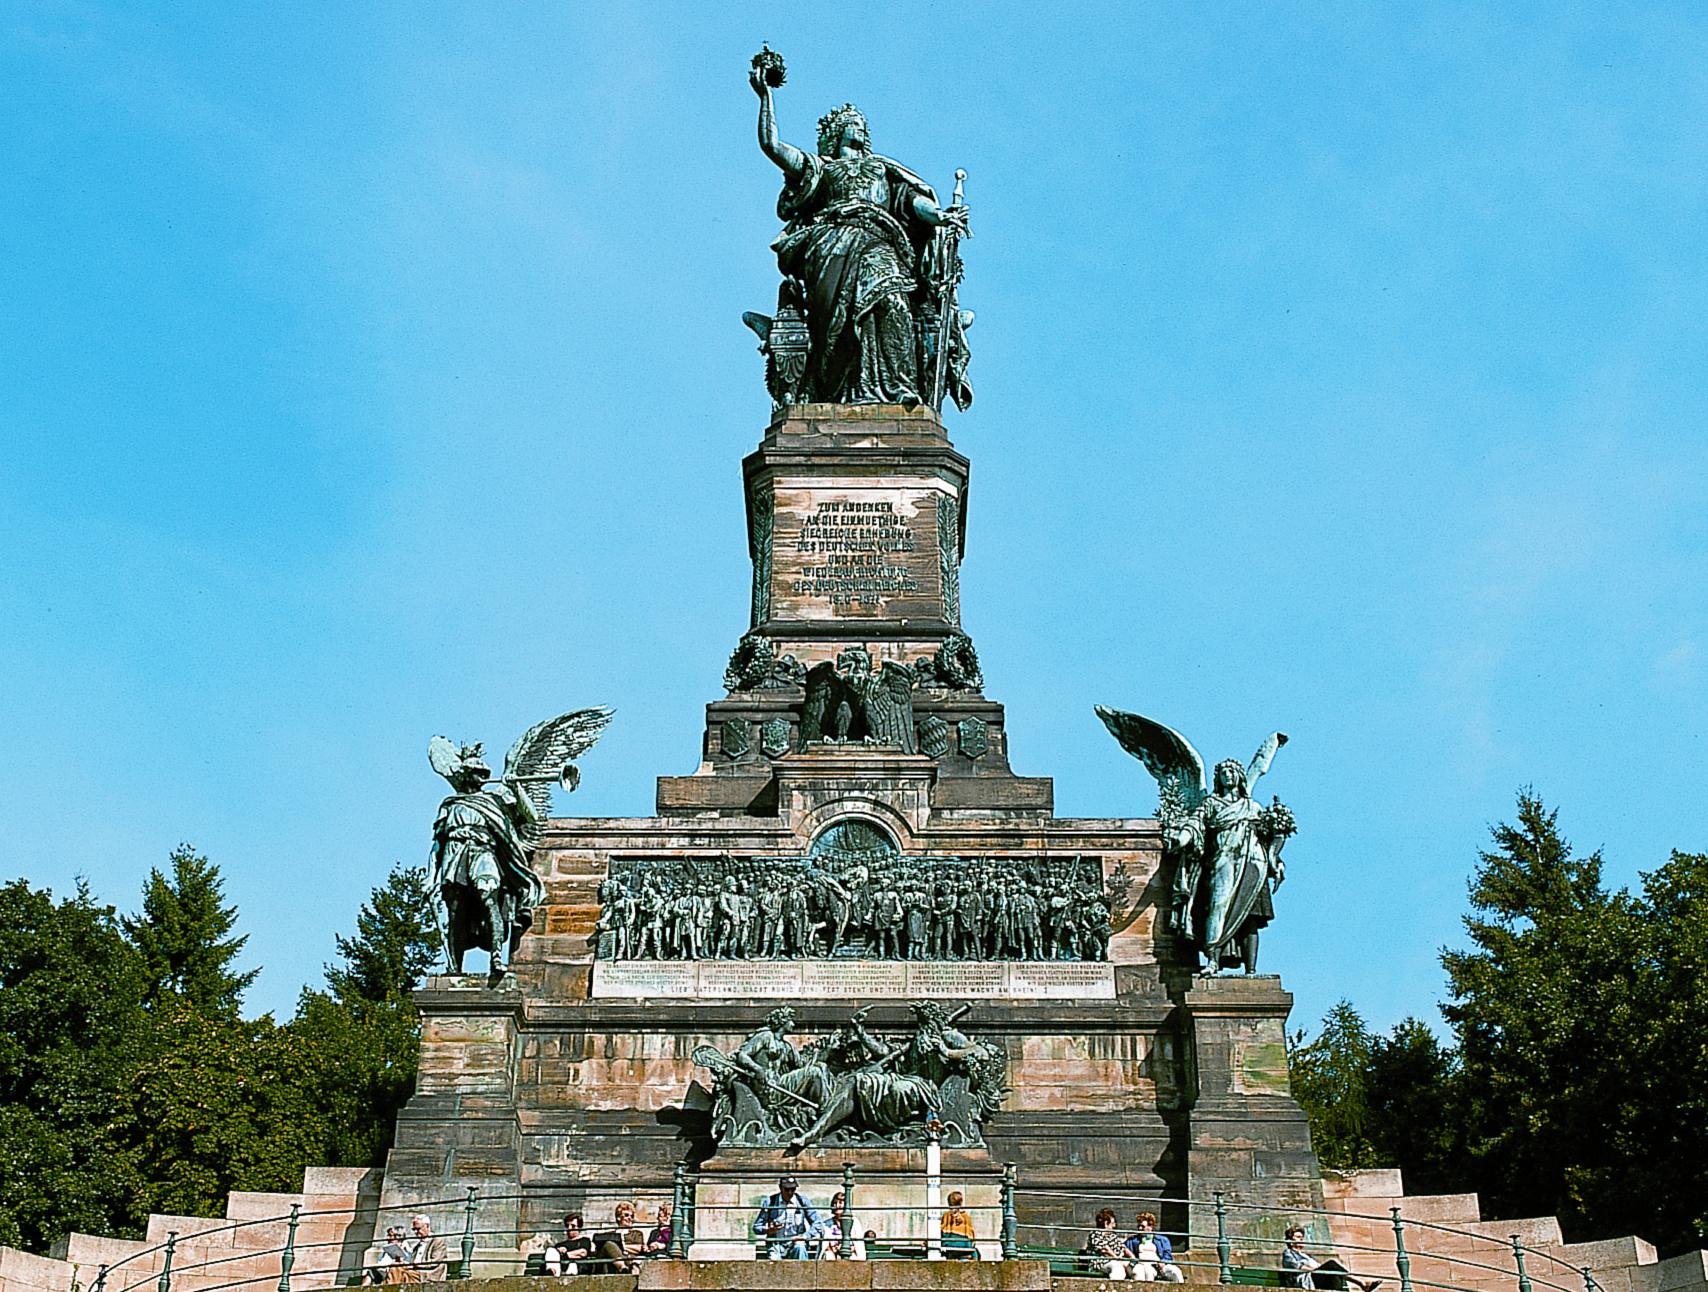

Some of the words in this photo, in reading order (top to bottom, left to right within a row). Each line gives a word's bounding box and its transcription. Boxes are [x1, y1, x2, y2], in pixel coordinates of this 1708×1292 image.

[818, 502, 840, 513] ZUM
[843, 501, 894, 513] ANDENKEN
[806, 515, 819, 526] AN
[822, 515, 839, 526] DIE
[840, 515, 905, 526] EINMUETHIGE
[799, 528, 858, 539] SIEGREICHE
[859, 528, 912, 539] ERHEBUNG
[797, 541, 816, 552] DES
[819, 541, 875, 552] DEUTSCHEN
[828, 554, 848, 565] UND
[850, 554, 864, 565] AN
[866, 554, 883, 565] DIE
[793, 580, 814, 592] DES
[816, 580, 874, 592] DEUTSCHEN
